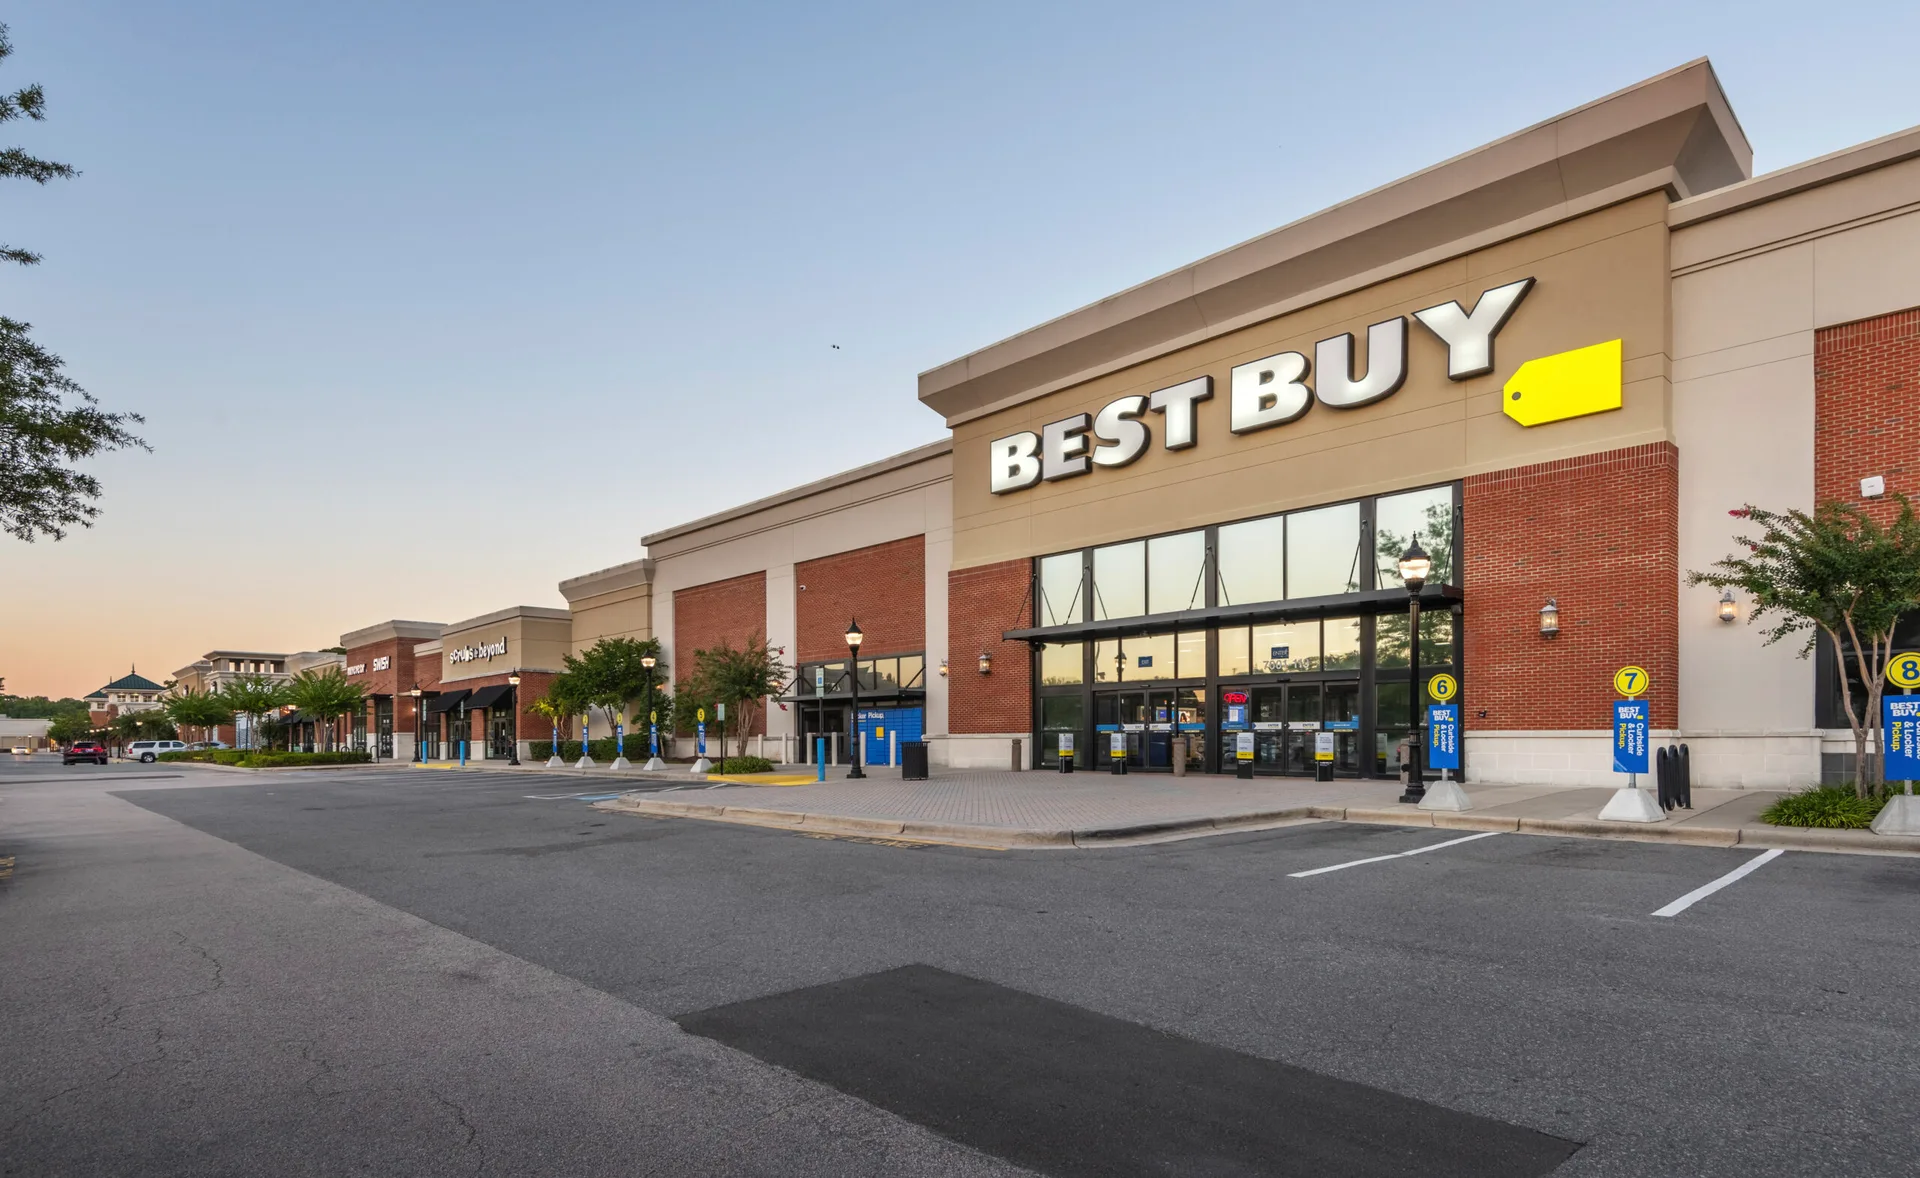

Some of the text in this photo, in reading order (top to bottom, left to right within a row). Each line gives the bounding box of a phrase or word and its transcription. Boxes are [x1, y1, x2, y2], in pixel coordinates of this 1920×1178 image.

[990, 276, 1537, 496] BEST BUY
[479, 636, 507, 662] beyond
[1263, 660, 1288, 670] 7001
[1901, 660, 1919, 680] 8
[1437, 680, 1448, 695] 6
[1624, 672, 1638, 690] 7
[1223, 693, 1247, 703] OPEN
[1890, 702, 1920, 710] BEST
[1892, 709, 1917, 717] BUY
[1636, 722, 1644, 756] Curbside
[1904, 729, 1915, 758] Locker
